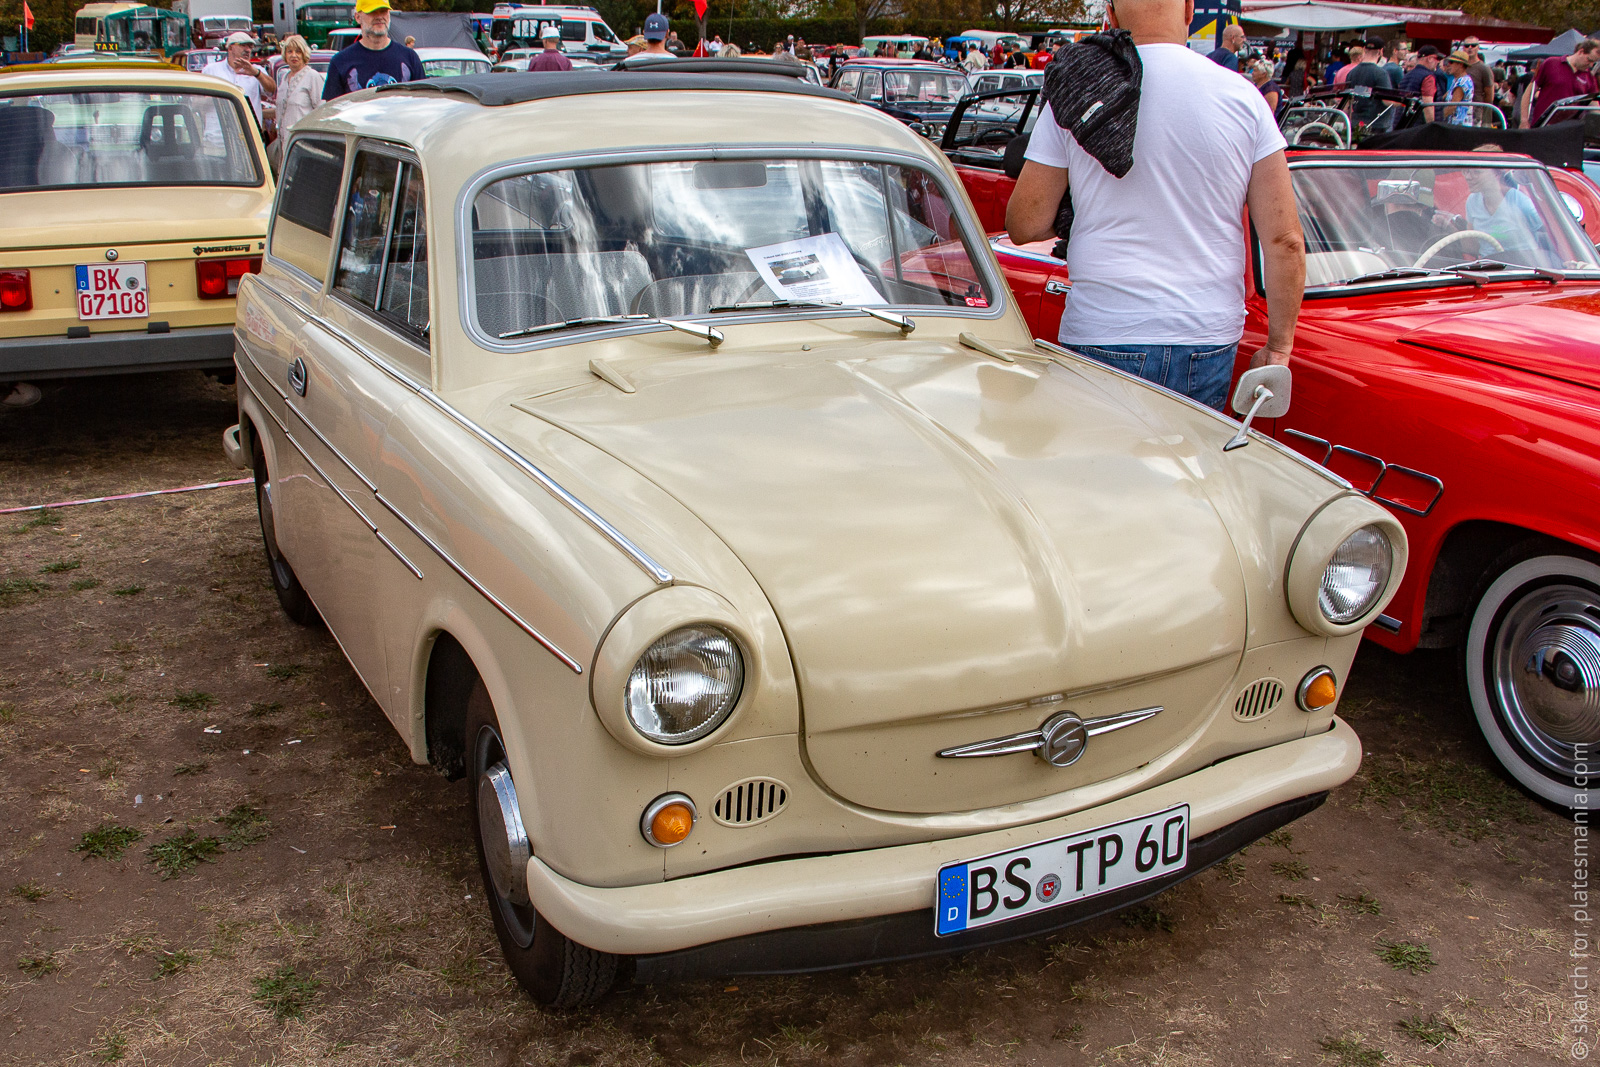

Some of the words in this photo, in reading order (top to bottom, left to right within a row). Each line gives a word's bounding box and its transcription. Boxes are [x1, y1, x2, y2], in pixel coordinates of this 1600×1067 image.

[95, 43, 118, 51] TAXI
[93, 268, 122, 291] BK
[80, 291, 146, 316] 07108
[969, 857, 1032, 920] BS
[1066, 833, 1124, 892] TP
[1134, 814, 1185, 873] 60
[947, 906, 959, 922] D
